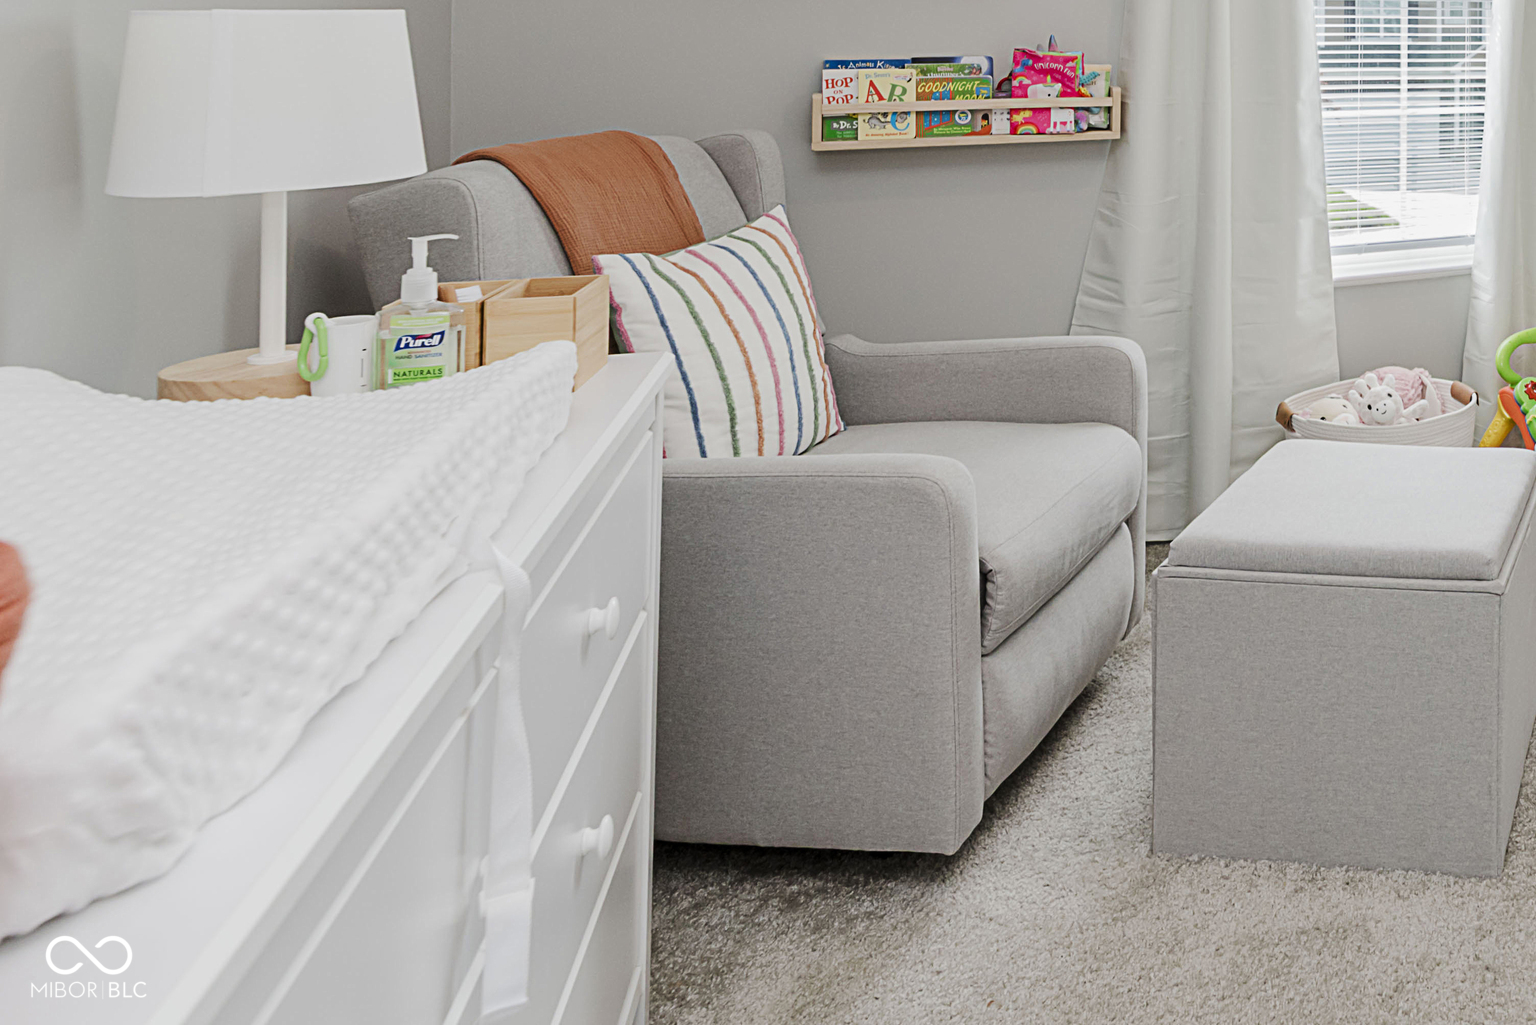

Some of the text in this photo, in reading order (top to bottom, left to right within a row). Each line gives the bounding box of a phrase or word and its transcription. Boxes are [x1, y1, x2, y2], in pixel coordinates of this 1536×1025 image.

[1034, 62, 1063, 72] unicorn
[824, 76, 853, 89] HOP
[917, 80, 981, 93] GOODNIGHT
[825, 93, 854, 105] POP
[839, 120, 852, 130] Dr.
[399, 335, 442, 348] Purell
[393, 368, 443, 377] NATURALS
